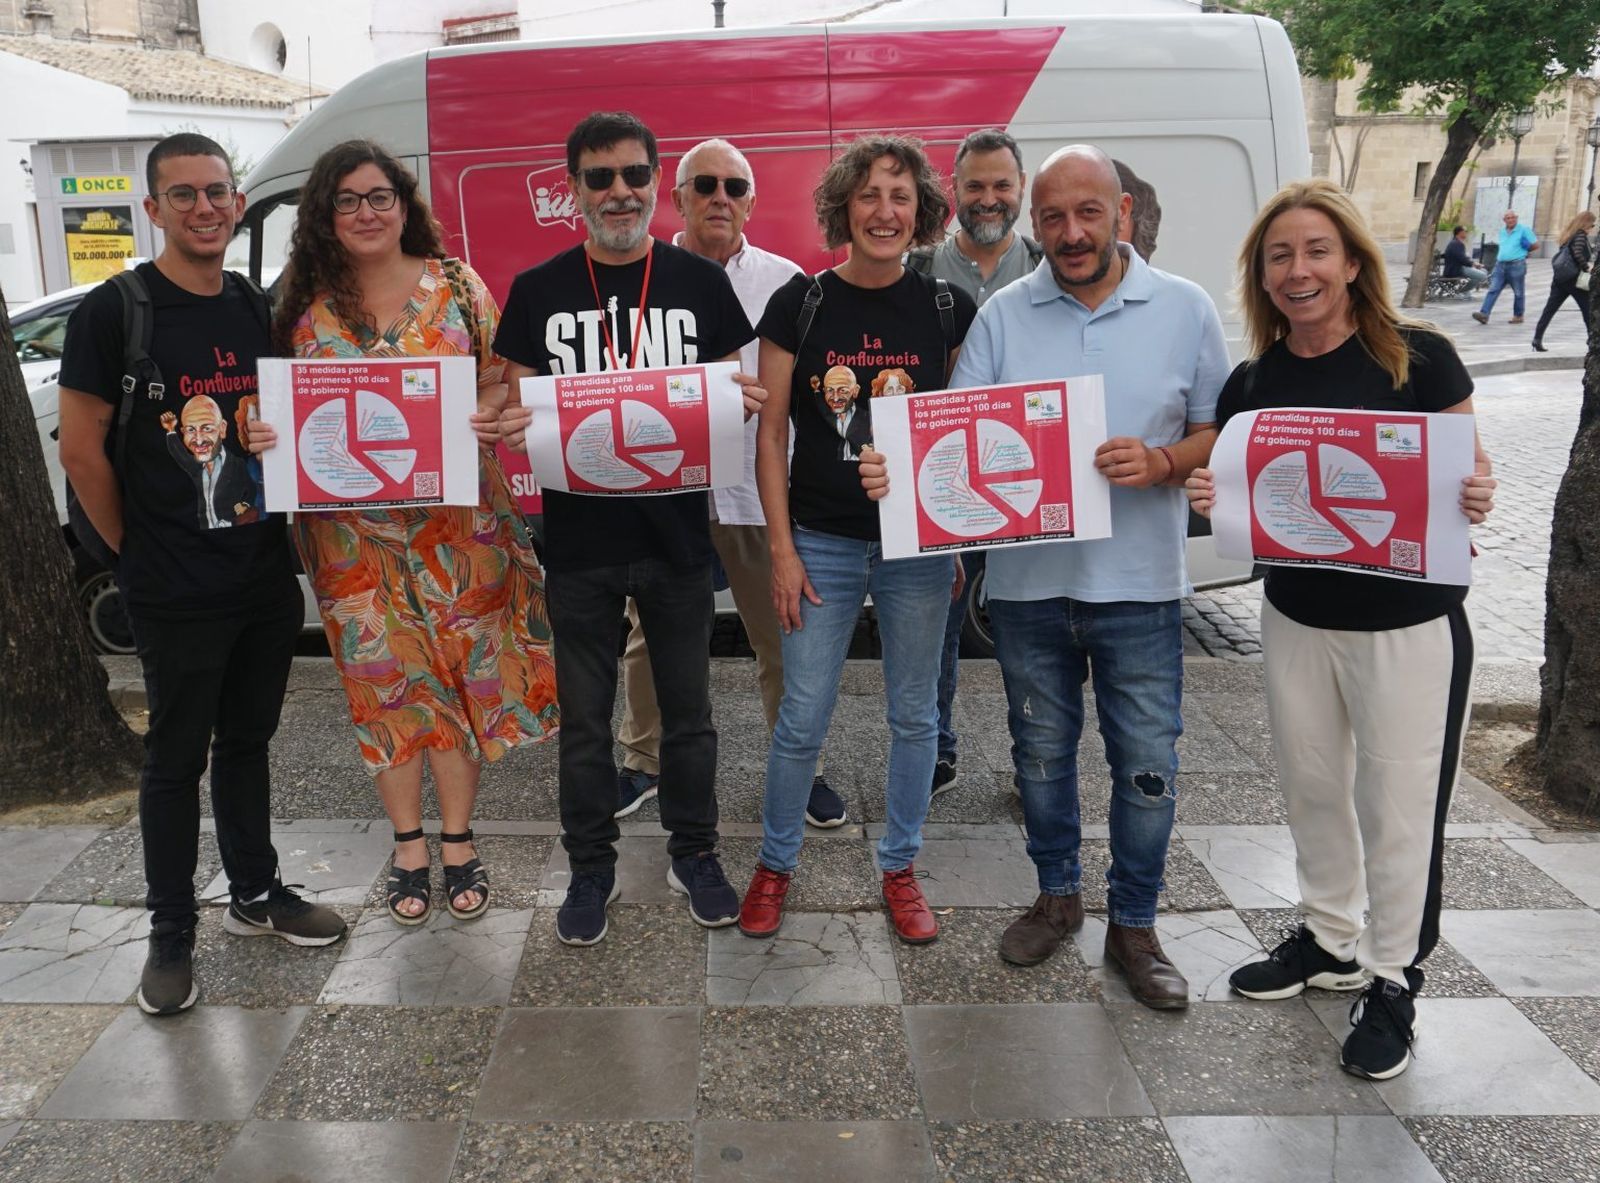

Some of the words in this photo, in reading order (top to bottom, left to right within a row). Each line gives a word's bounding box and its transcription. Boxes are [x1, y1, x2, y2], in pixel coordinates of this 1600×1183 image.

[82, 179, 125, 191] ONCE
[73, 250, 124, 260] 120.000.000
[127, 250, 133, 258] €
[863, 334, 883, 350] La
[214, 346, 237, 368] La
[826, 350, 920, 366] Confluencia
[309, 366, 346, 374] medidas
[348, 367, 368, 376] para
[312, 376, 352, 386] primeros
[353, 375, 369, 384] 100
[371, 375, 389, 383] días
[560, 379, 572, 388] 35
[574, 377, 611, 387] medidas
[612, 376, 632, 386] para
[311, 386, 350, 395] gobierno
[562, 389, 574, 398] los
[576, 386, 616, 398] primeros
[618, 384, 634, 393] 100
[635, 382, 654, 392] días
[562, 399, 574, 408] de
[576, 396, 615, 408] gobierno
[914, 399, 925, 408] 35
[927, 395, 966, 406] medidas
[967, 393, 988, 404] para
[914, 410, 928, 419] los
[930, 406, 971, 418] primeros
[973, 403, 990, 412] 100
[992, 401, 1012, 410] días
[915, 421, 927, 429] de
[929, 416, 970, 429] gobierno
[1259, 414, 1271, 422] 35
[1272, 414, 1311, 424] medidas
[1312, 416, 1335, 426] para
[1256, 424, 1270, 432] los
[1271, 424, 1314, 436] primeros
[1316, 426, 1335, 436] 100
[1337, 426, 1360, 437] días
[1254, 436, 1266, 444] de
[1268, 436, 1311, 447] gobierno
[512, 473, 542, 497] SU
